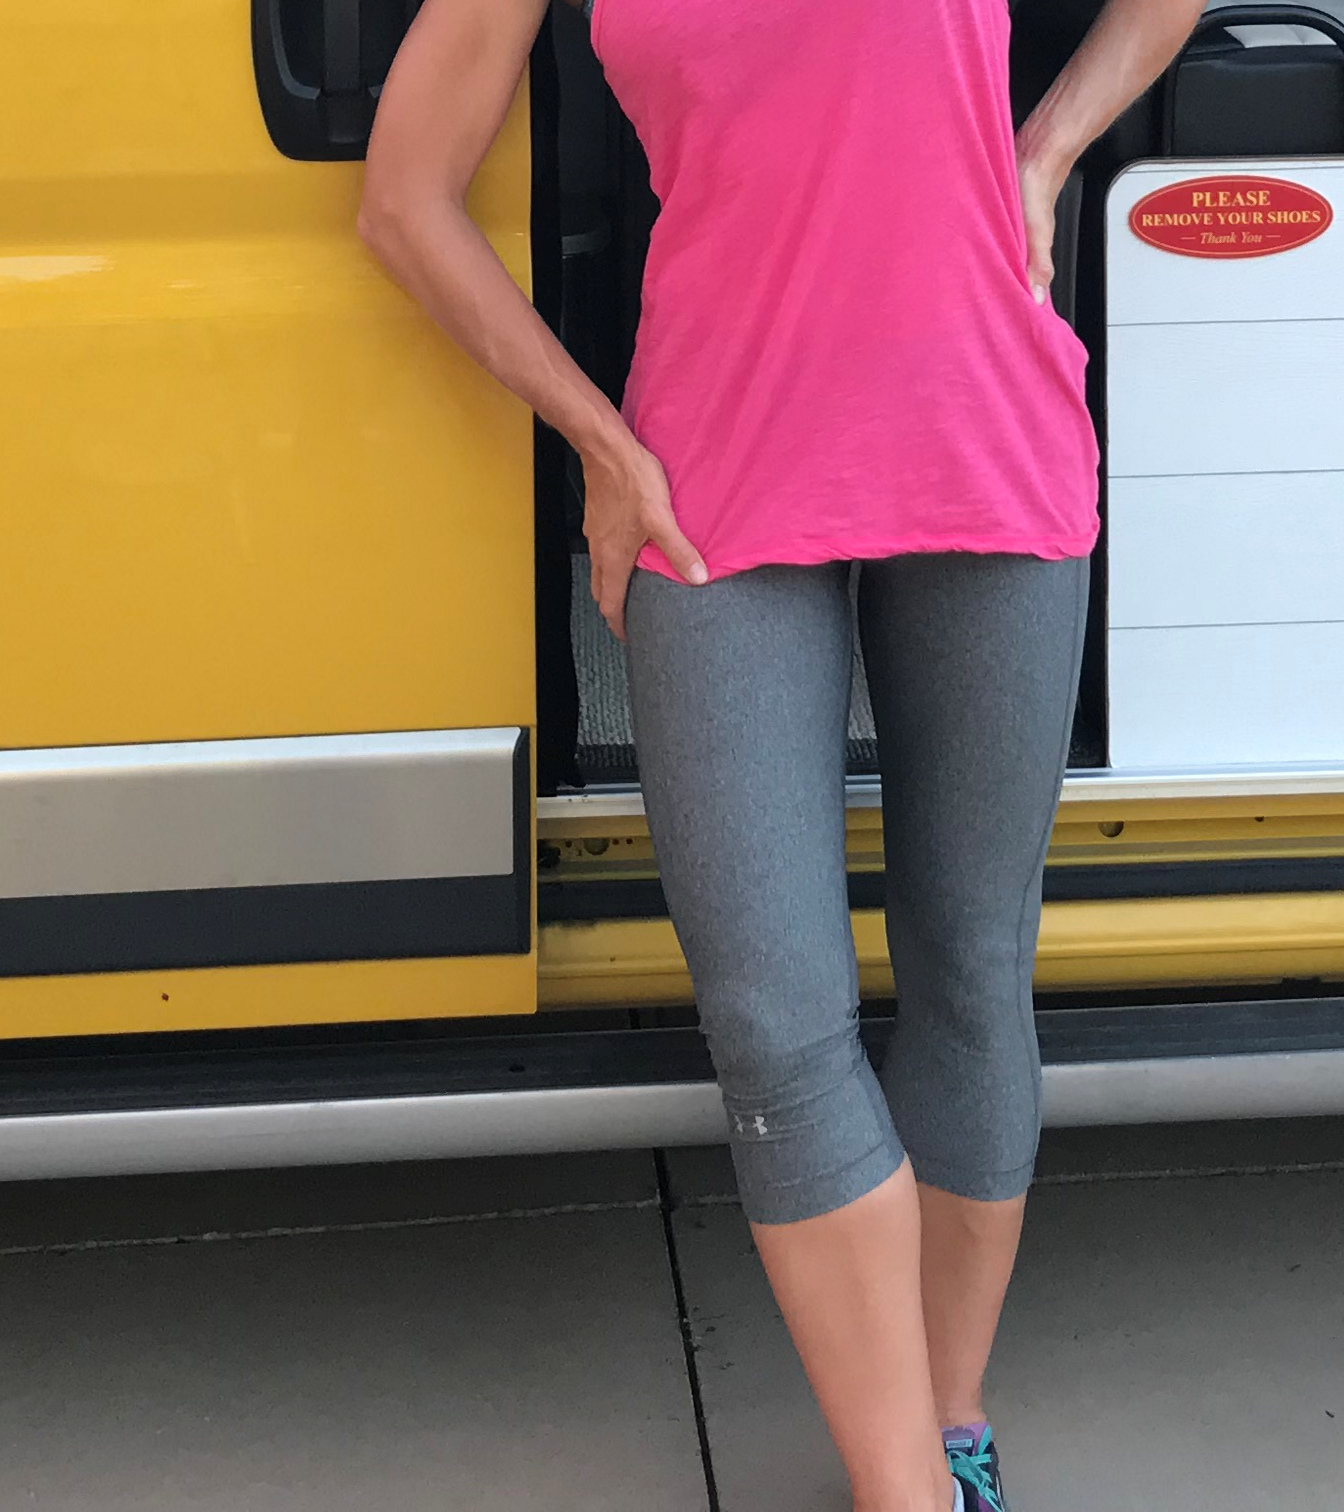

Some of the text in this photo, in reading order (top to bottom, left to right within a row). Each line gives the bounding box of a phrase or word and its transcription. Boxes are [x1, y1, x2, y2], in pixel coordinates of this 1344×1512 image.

[1191, 190, 1271, 207] PLEASE
[1141, 210, 1322, 227] REMOVE YOUR SHOES
[1200, 231, 1263, 245] Thank You
